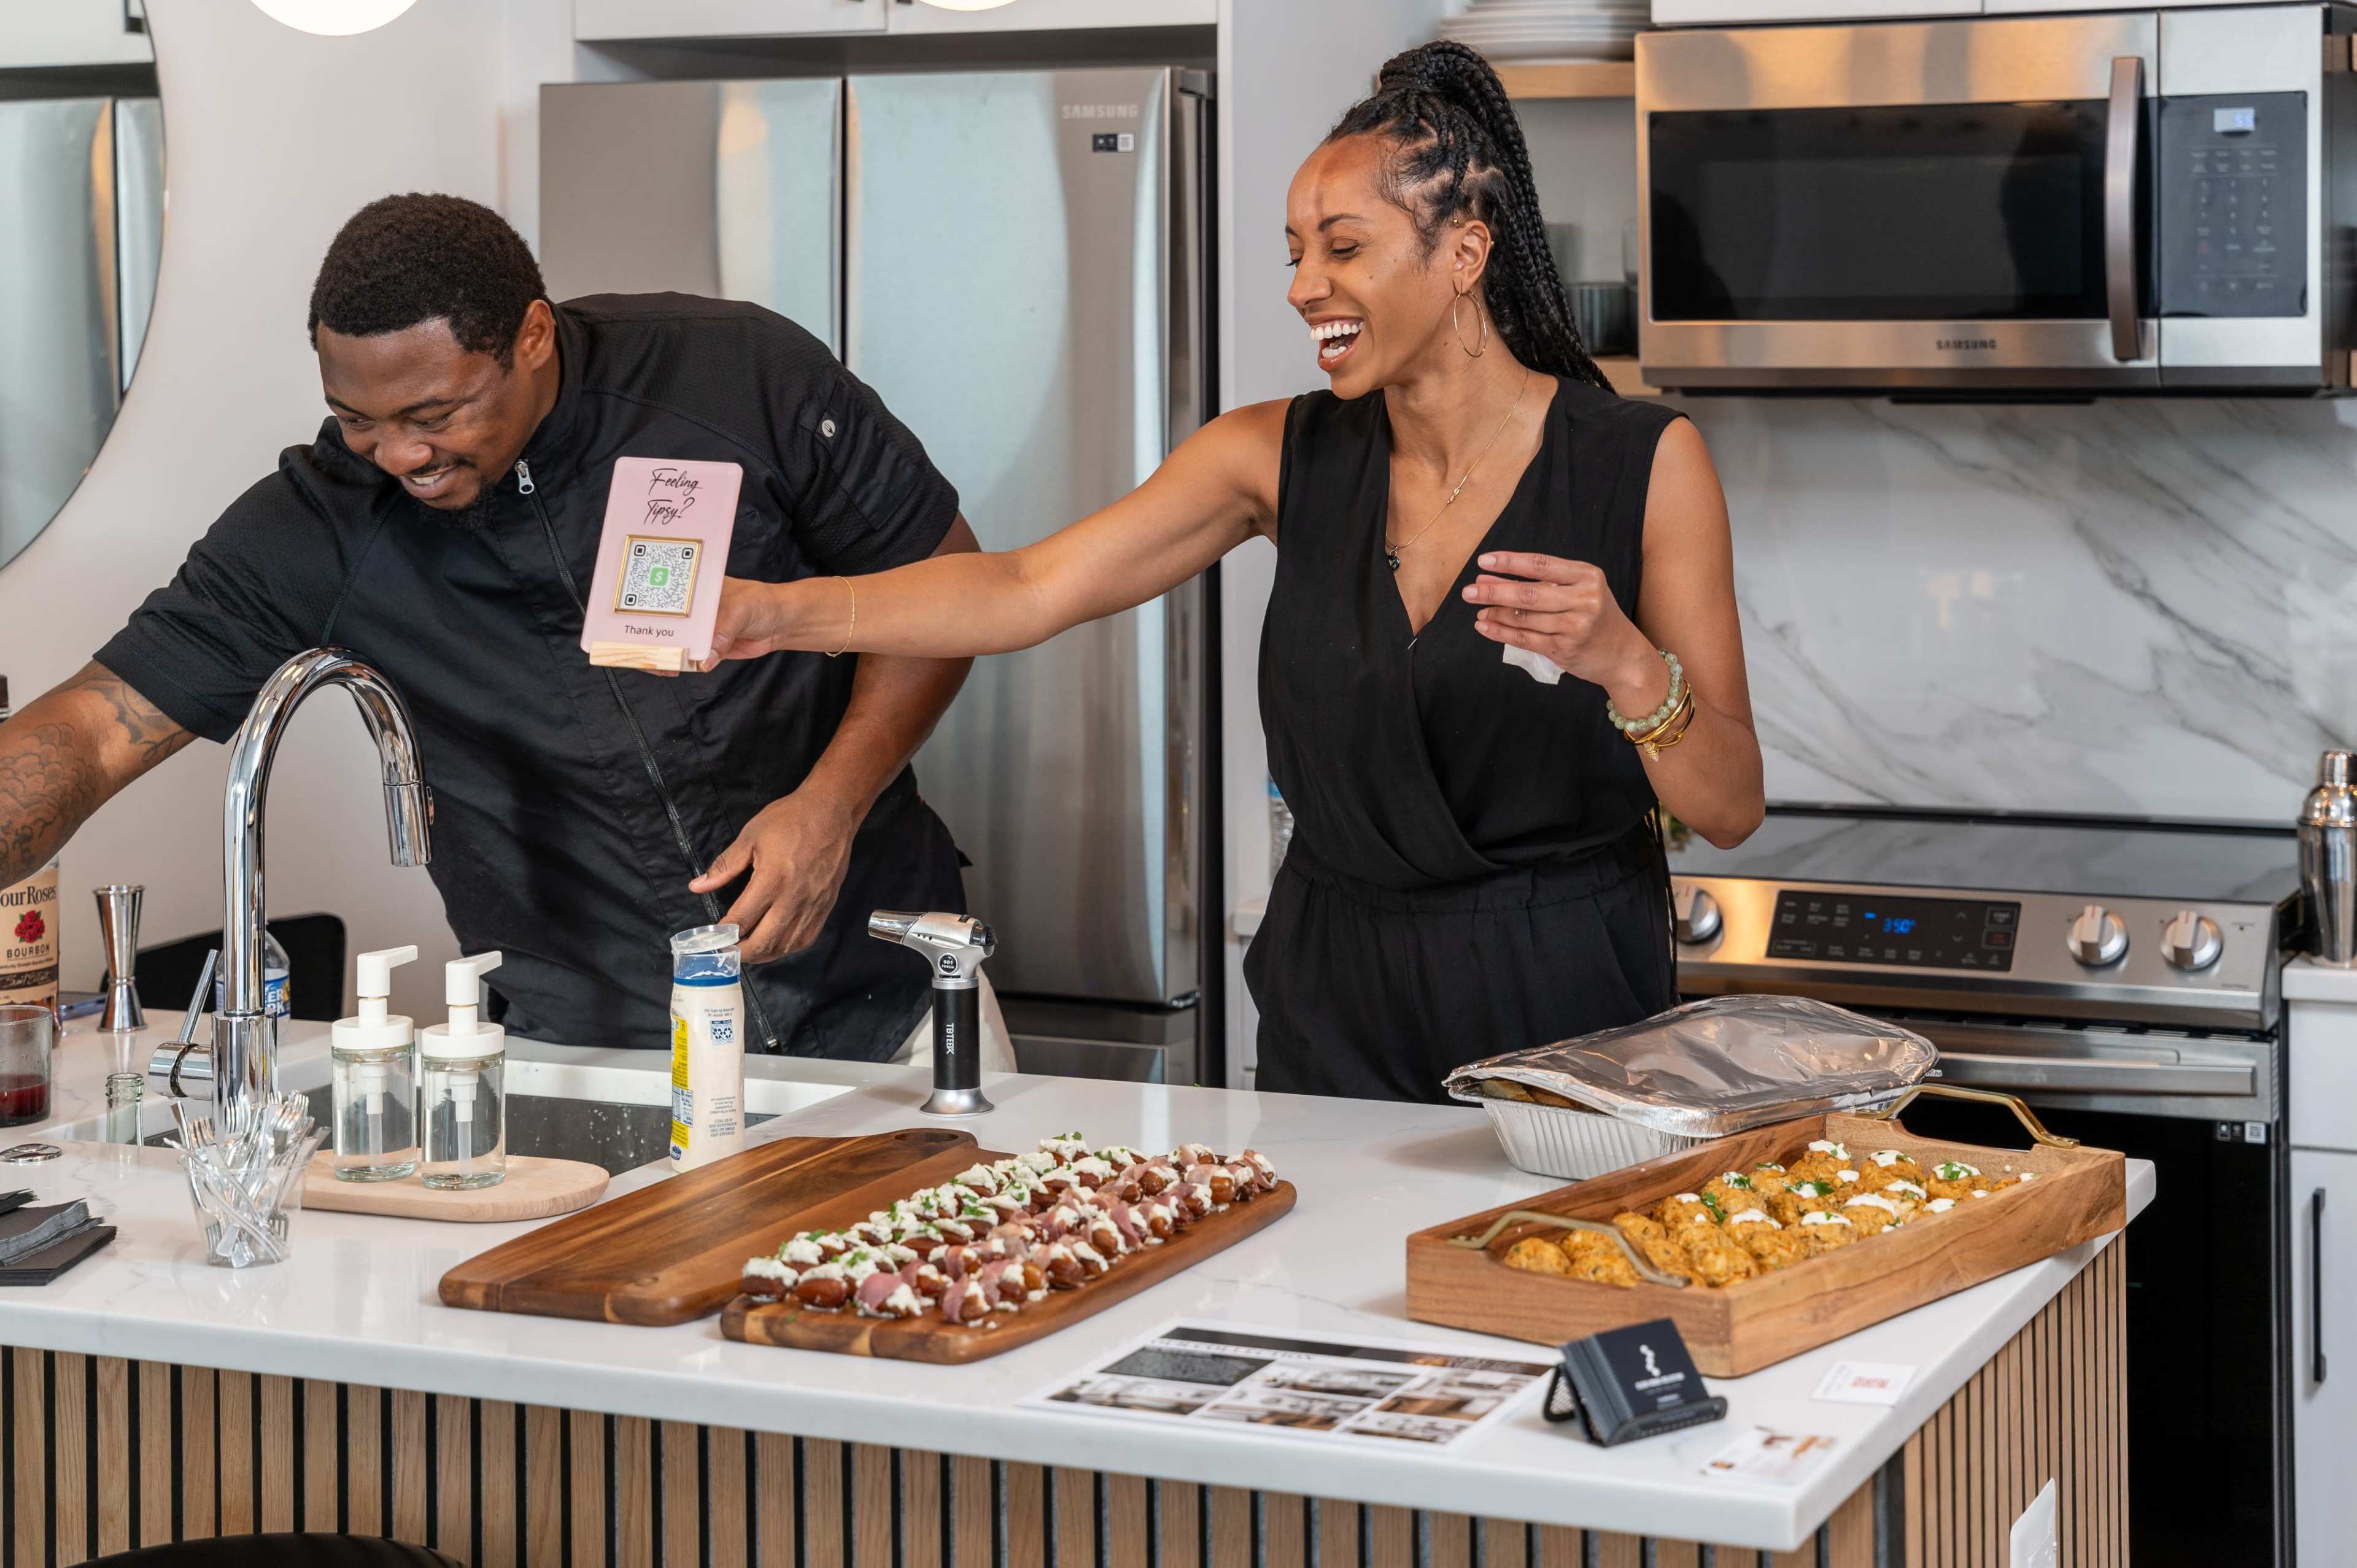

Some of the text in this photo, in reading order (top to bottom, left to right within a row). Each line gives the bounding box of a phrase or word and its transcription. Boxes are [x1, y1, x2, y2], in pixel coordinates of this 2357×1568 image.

[1061, 104, 1139, 119] SAMSUNG
[1935, 339, 1997, 350] SAMSUNG
[648, 468, 703, 496] Feeling
[643, 497, 695, 525] Tipsy?
[624, 625, 674, 638] Thank you
[0, 891, 26, 906] our
[7, 943, 50, 959] BOURBON
[945, 1022, 955, 1055] TBTEEK
